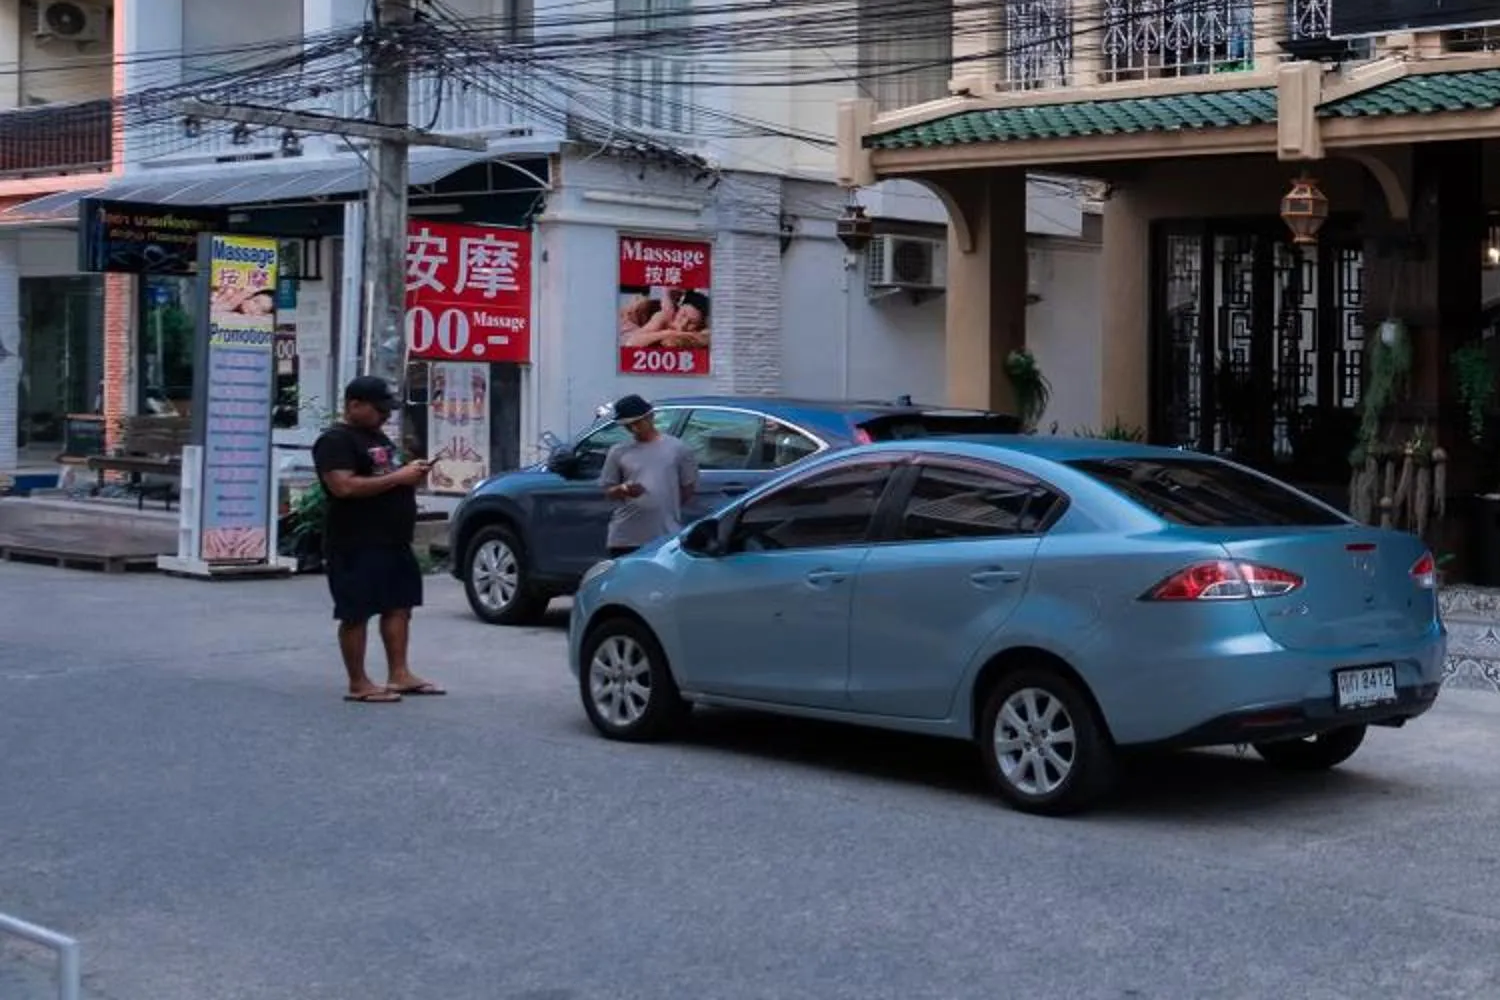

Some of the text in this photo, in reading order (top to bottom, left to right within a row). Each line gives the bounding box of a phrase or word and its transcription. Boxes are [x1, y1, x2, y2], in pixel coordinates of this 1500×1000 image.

[212, 240, 275, 269] Massage
[621, 240, 705, 272] Massage
[644, 266, 683, 285] 按摩
[209, 323, 273, 345] Promotion
[404, 306, 509, 356] 00.-
[472, 311, 527, 333] Massage
